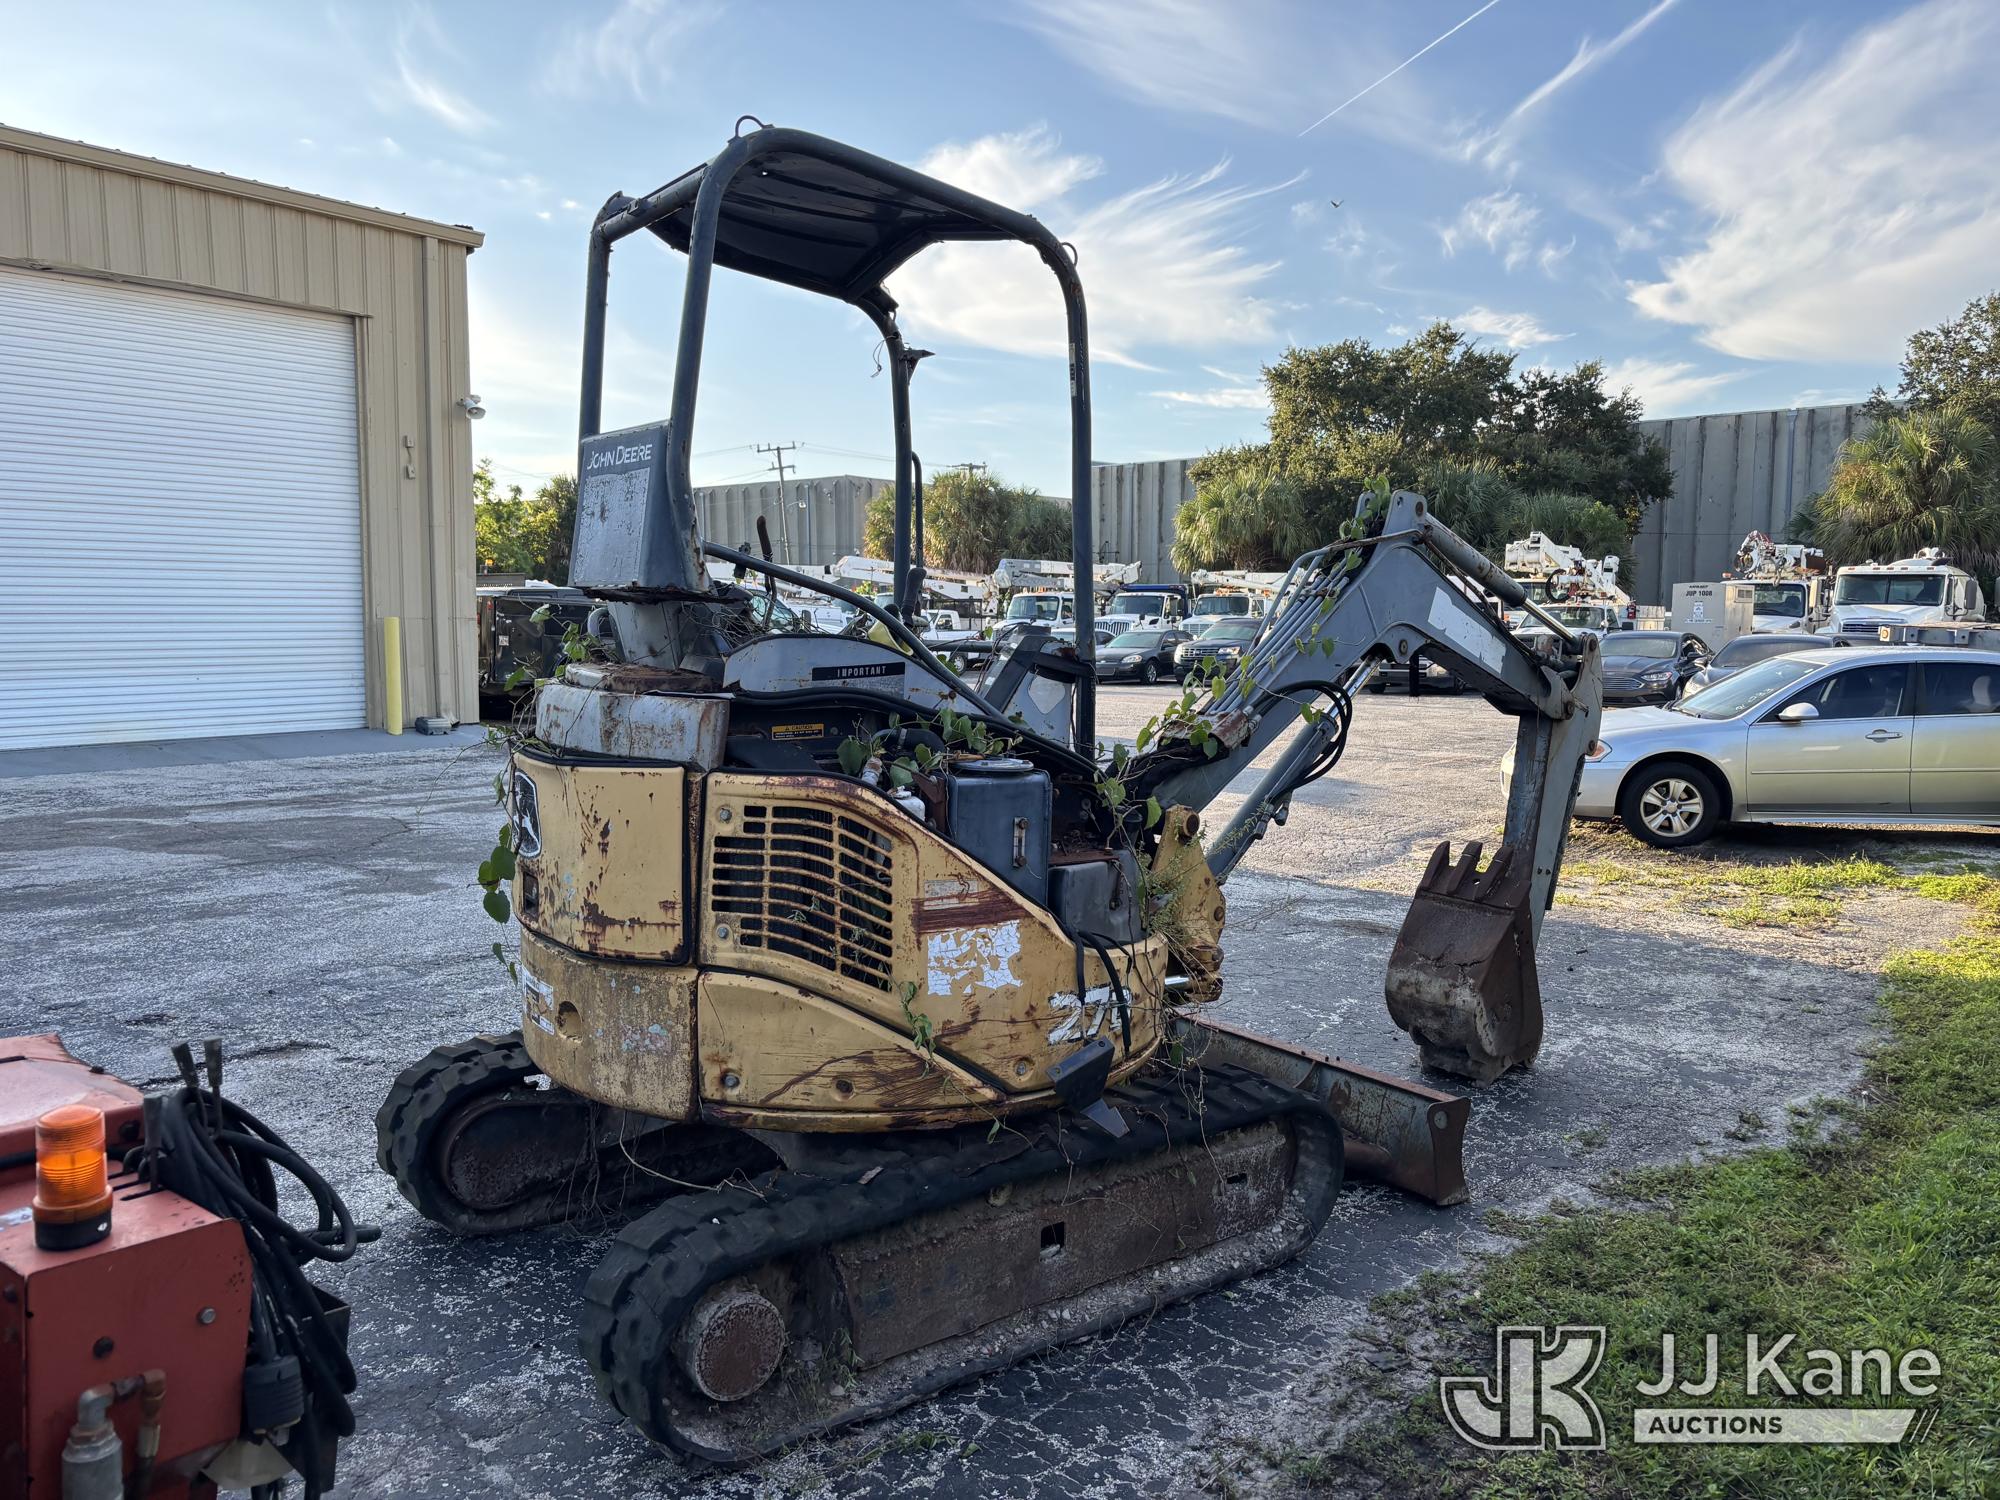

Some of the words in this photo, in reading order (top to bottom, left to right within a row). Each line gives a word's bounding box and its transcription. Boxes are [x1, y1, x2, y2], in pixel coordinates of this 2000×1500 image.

[586, 450, 616, 470] JOHN
[615, 443, 653, 464] DEERE
[837, 665, 887, 678] IMPORTANT
